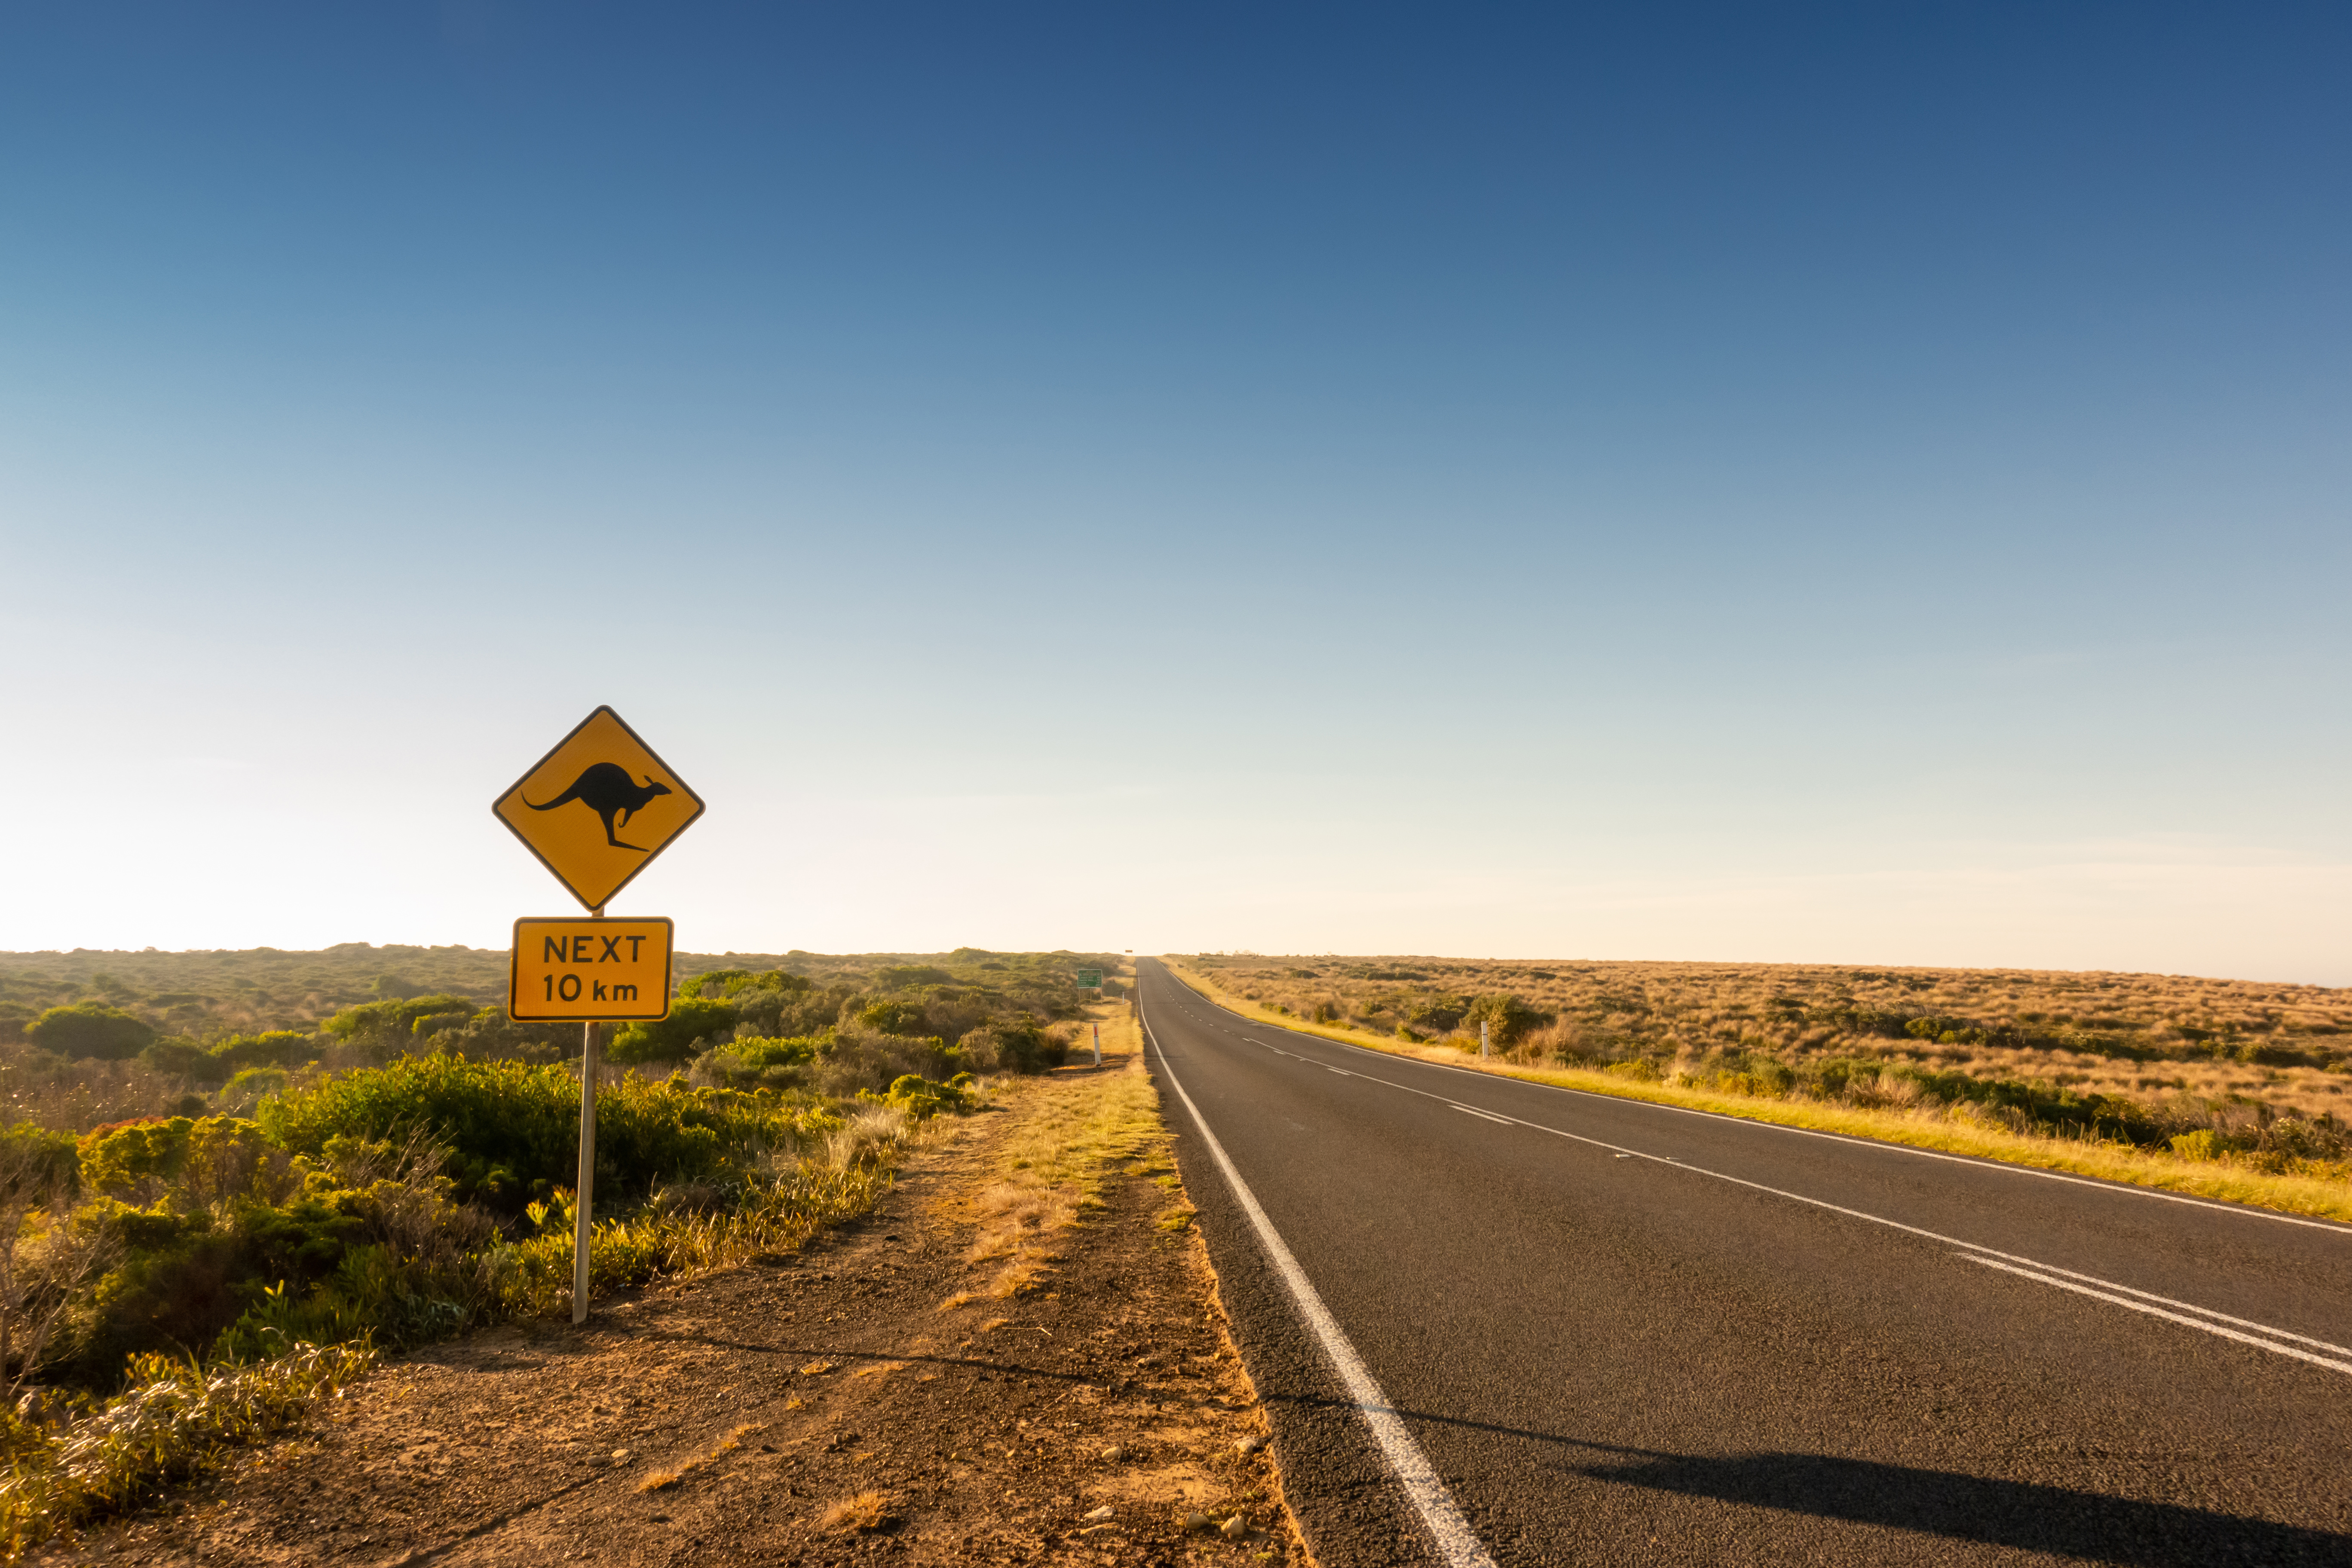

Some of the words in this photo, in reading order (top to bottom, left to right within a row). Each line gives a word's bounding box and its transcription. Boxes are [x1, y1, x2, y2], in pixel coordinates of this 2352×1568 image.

[544, 936, 646, 963] NEXT
[544, 974, 582, 1001] 10
[593, 980, 637, 1001] km
